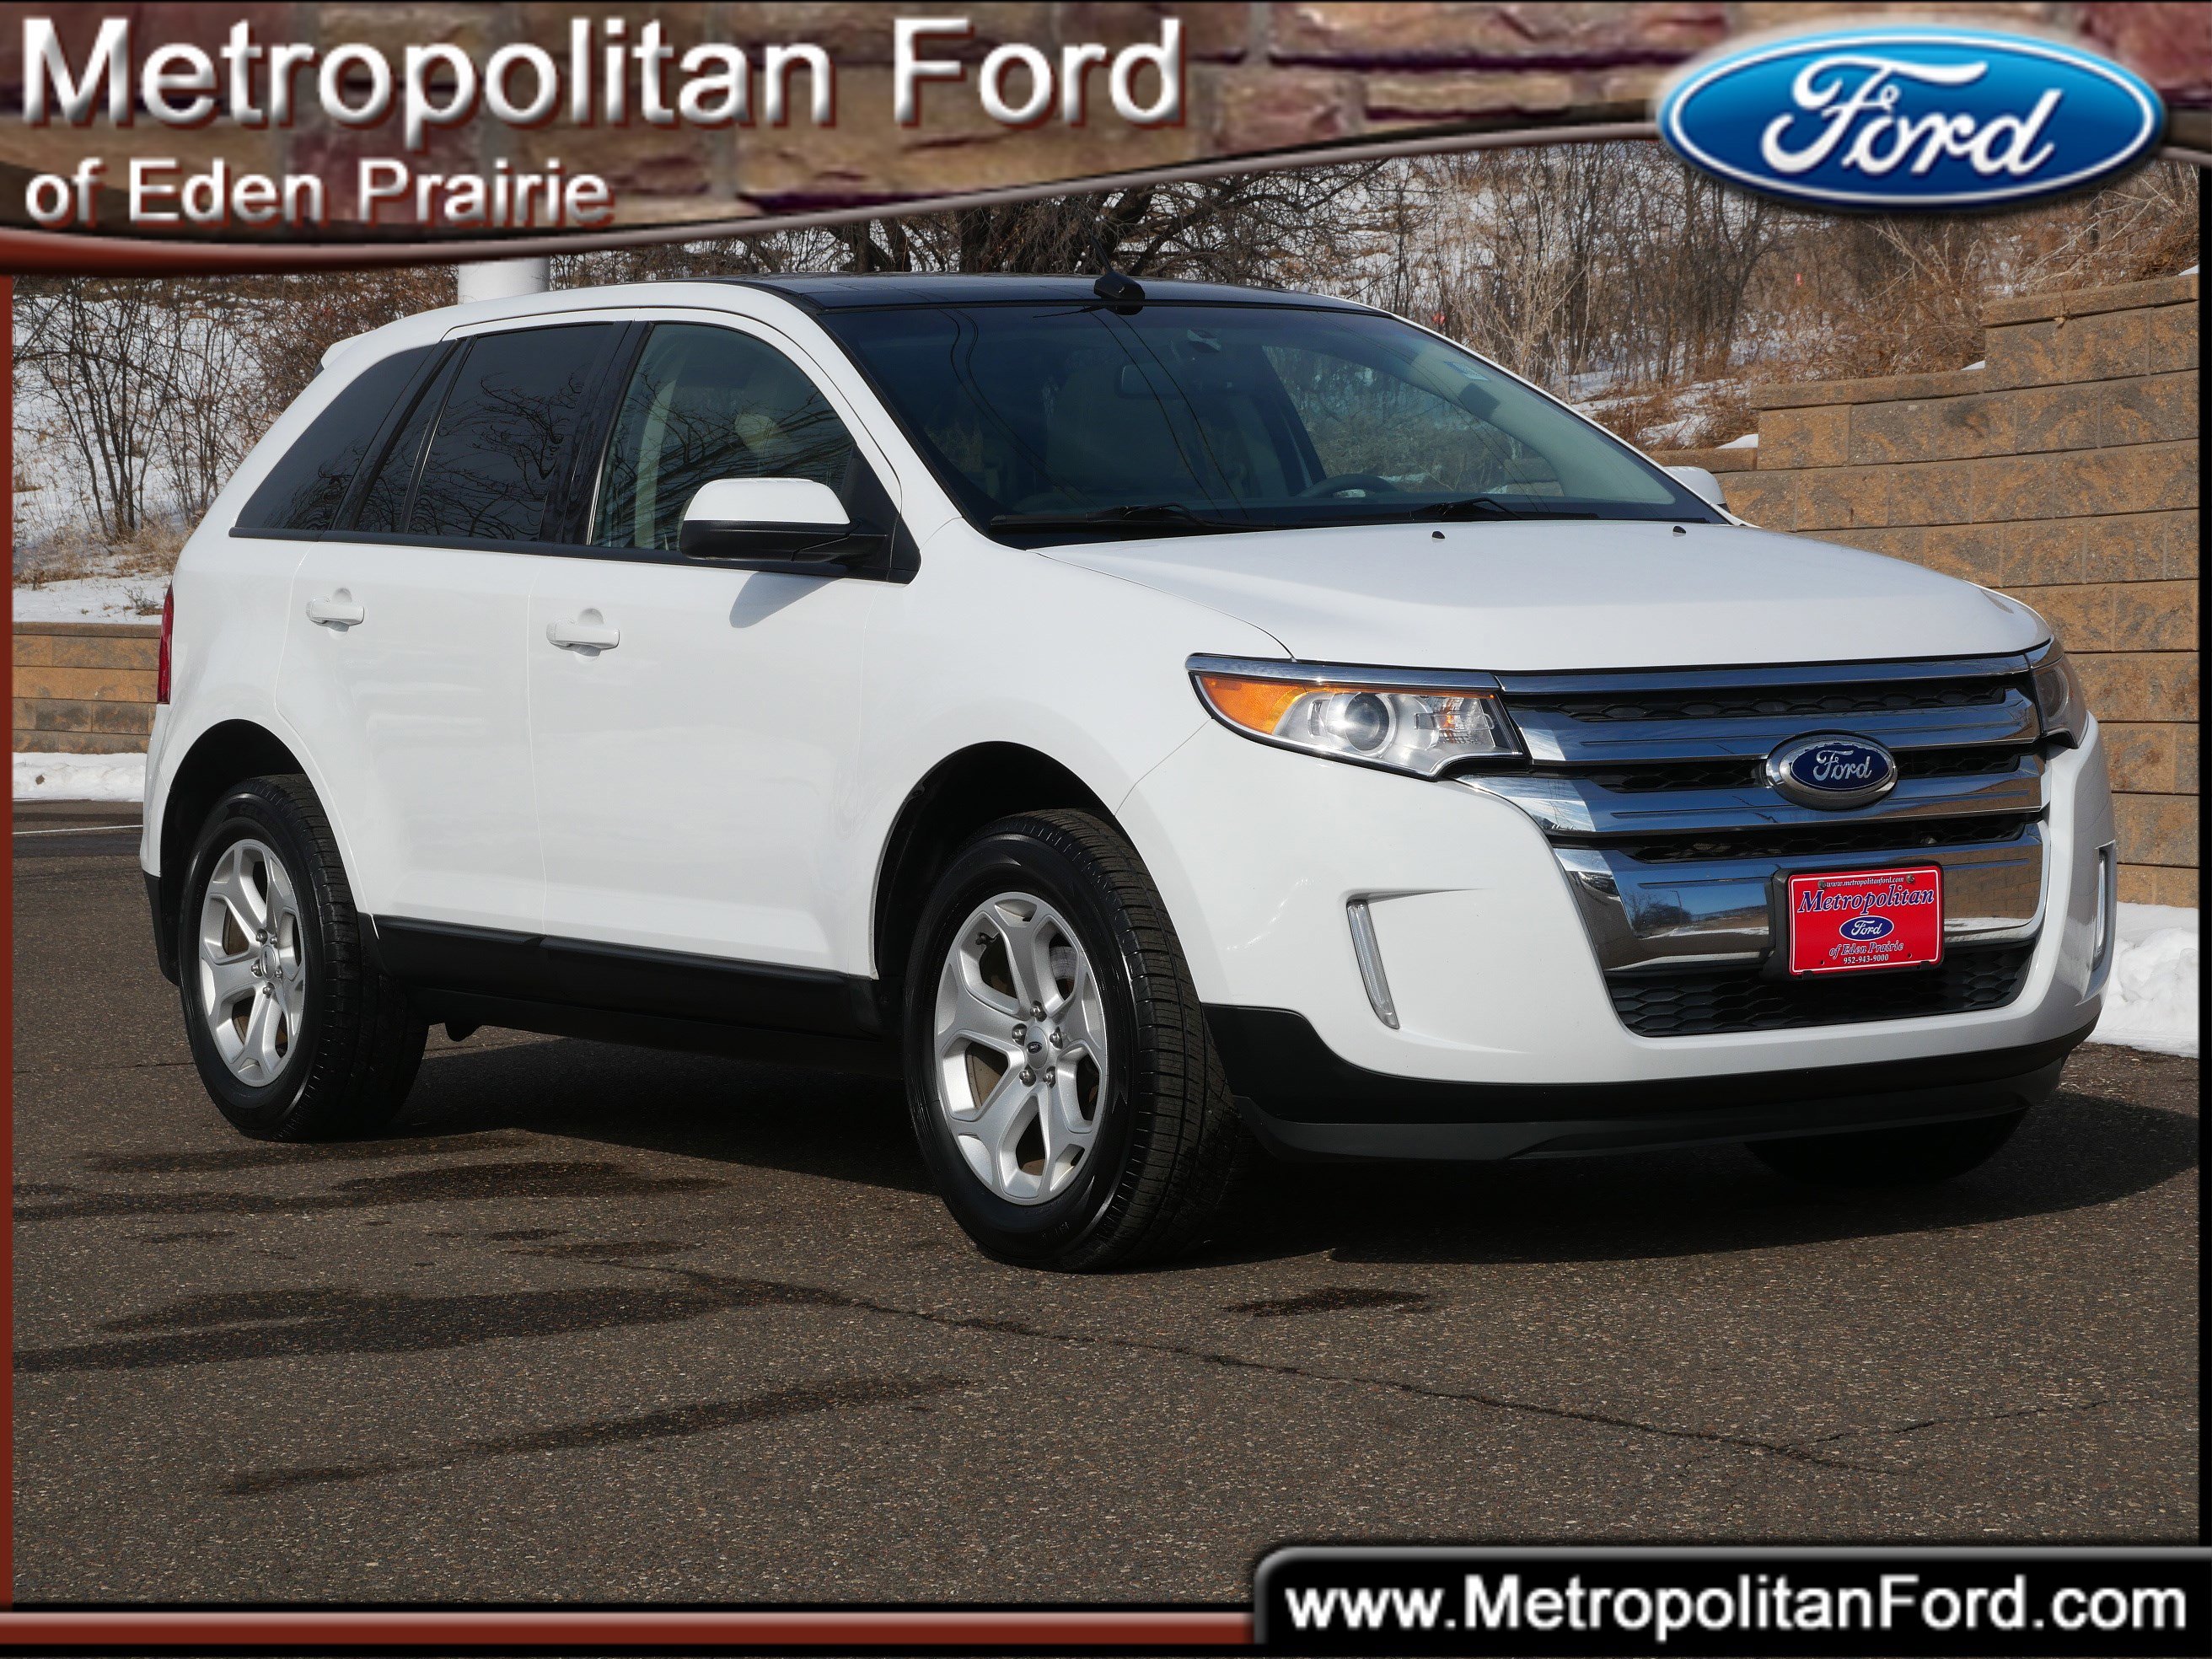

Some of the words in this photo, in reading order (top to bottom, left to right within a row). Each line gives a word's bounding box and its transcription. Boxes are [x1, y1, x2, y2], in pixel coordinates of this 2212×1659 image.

[1812, 749, 1872, 781] Ford
[1826, 876, 1904, 888] www.metropolitanford.com
[1796, 883, 1935, 915] Metropolitan
[1851, 920, 1882, 936] Ford
[1828, 943, 1842, 959] of
[1841, 943, 1866, 956] Eden
[1867, 940, 1904, 953] Prairie
[1843, 953, 1889, 964] 952-943-9000
